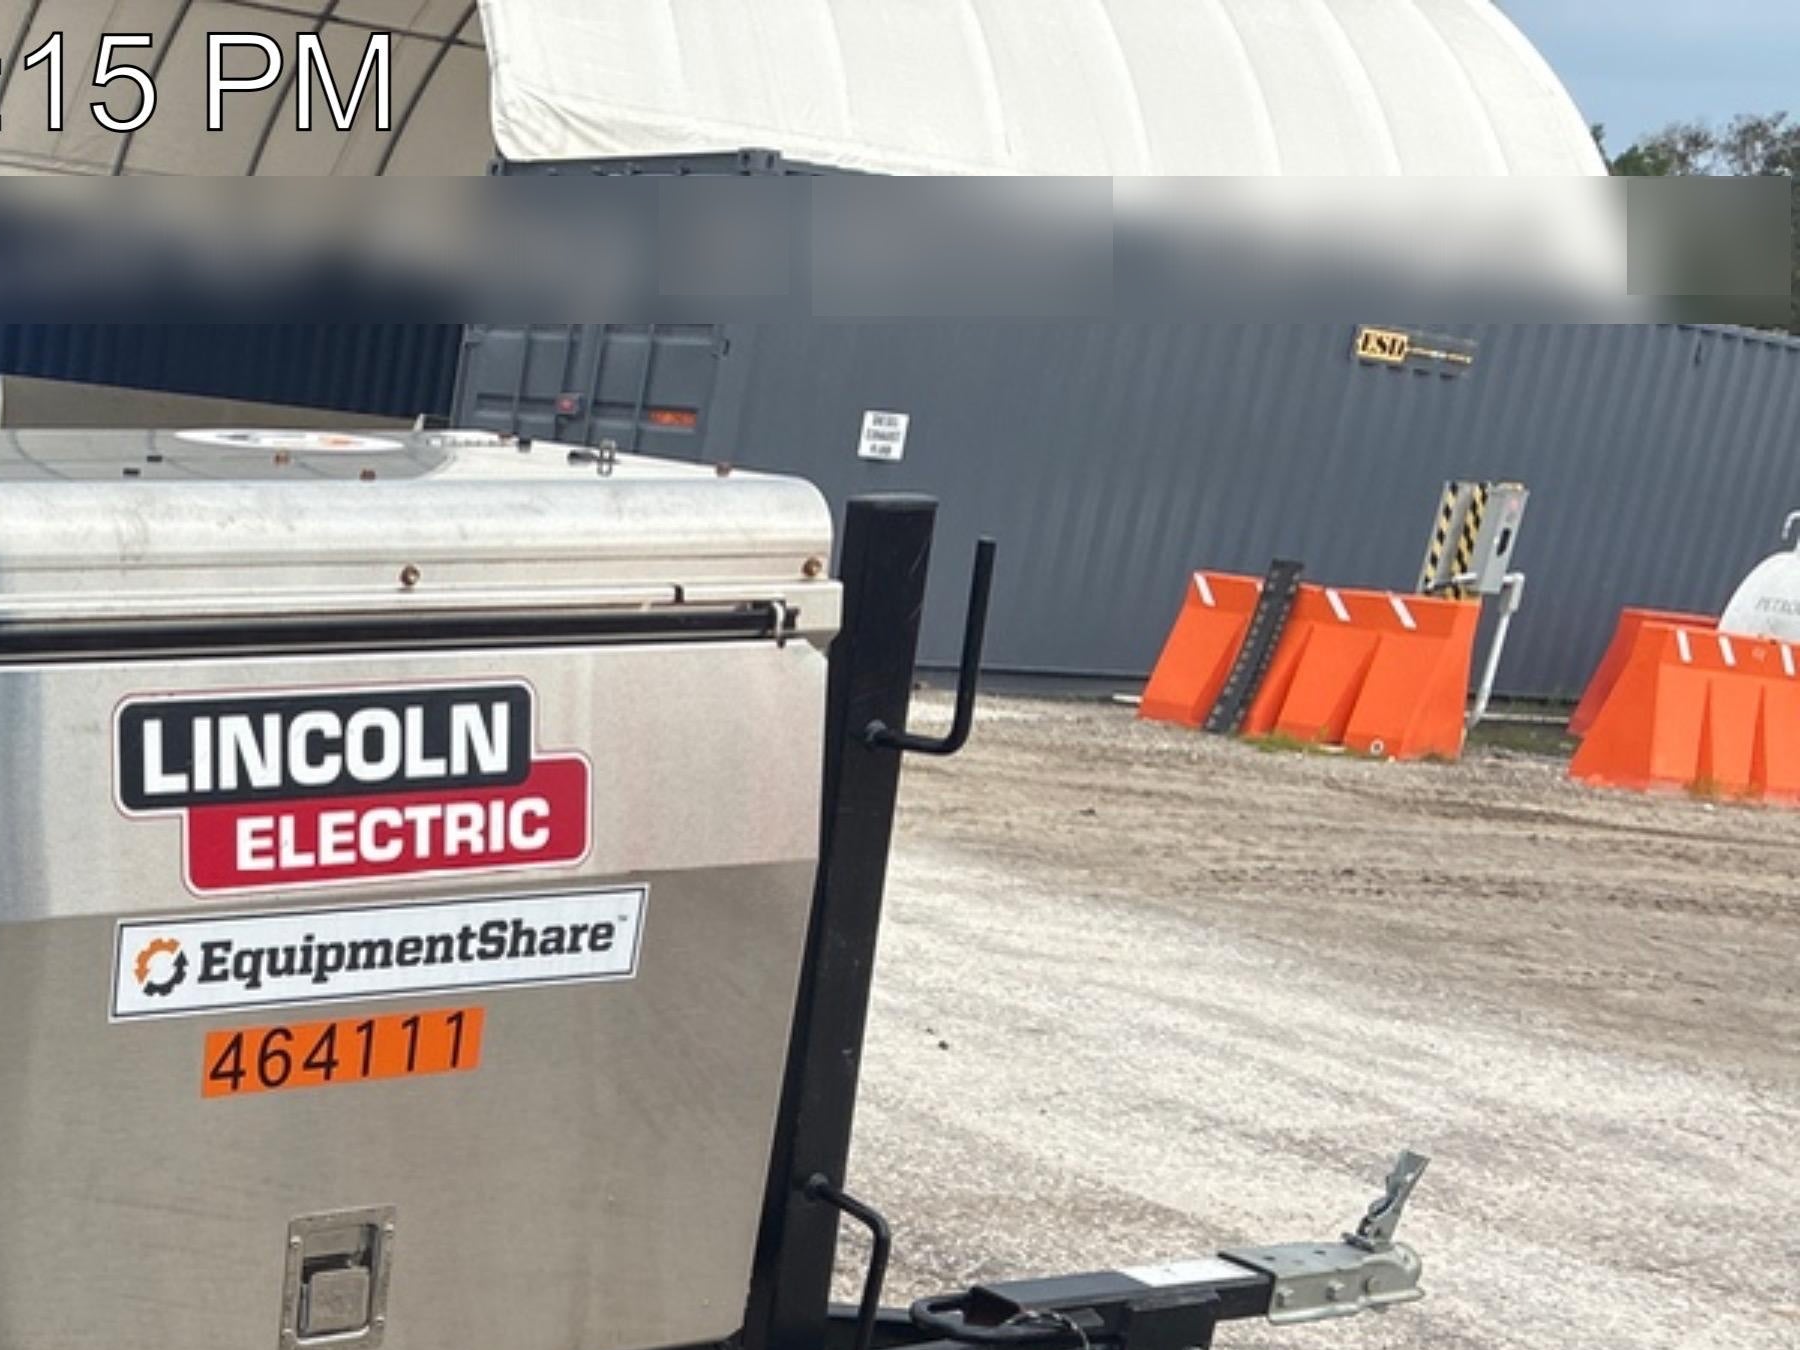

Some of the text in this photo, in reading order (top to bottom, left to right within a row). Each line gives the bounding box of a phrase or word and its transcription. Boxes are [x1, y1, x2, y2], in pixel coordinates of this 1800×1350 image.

[143, 701, 510, 794] LINCOLN
[236, 797, 550, 871] ELECTRIC
[198, 919, 616, 990] EquipmentShare
[209, 1010, 466, 1091] 464111
